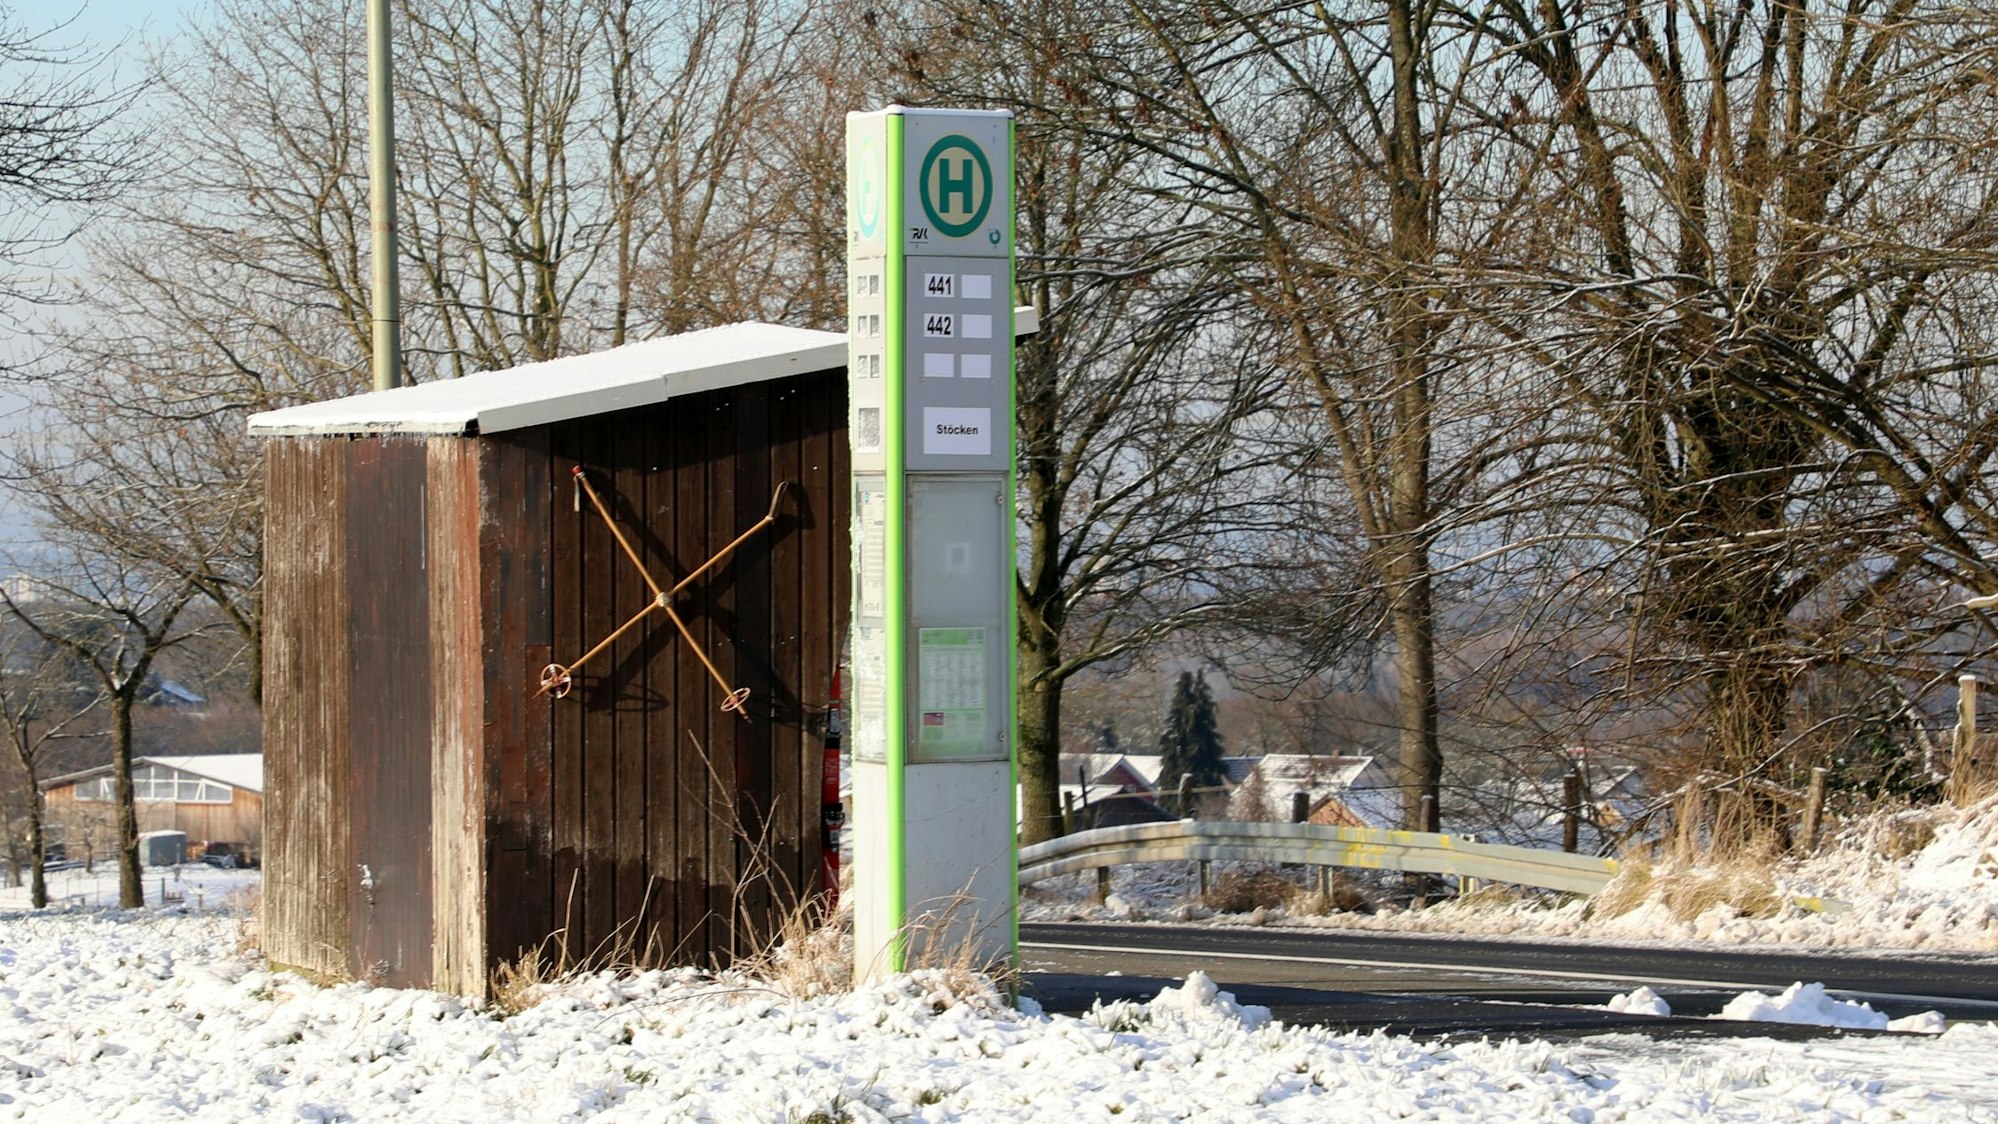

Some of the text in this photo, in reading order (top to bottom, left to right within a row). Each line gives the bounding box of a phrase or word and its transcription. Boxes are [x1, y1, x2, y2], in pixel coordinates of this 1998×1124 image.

[939, 158, 973, 214] H
[928, 275, 951, 295] 441
[927, 315, 951, 336] 442
[936, 424, 979, 435] Stöcken
